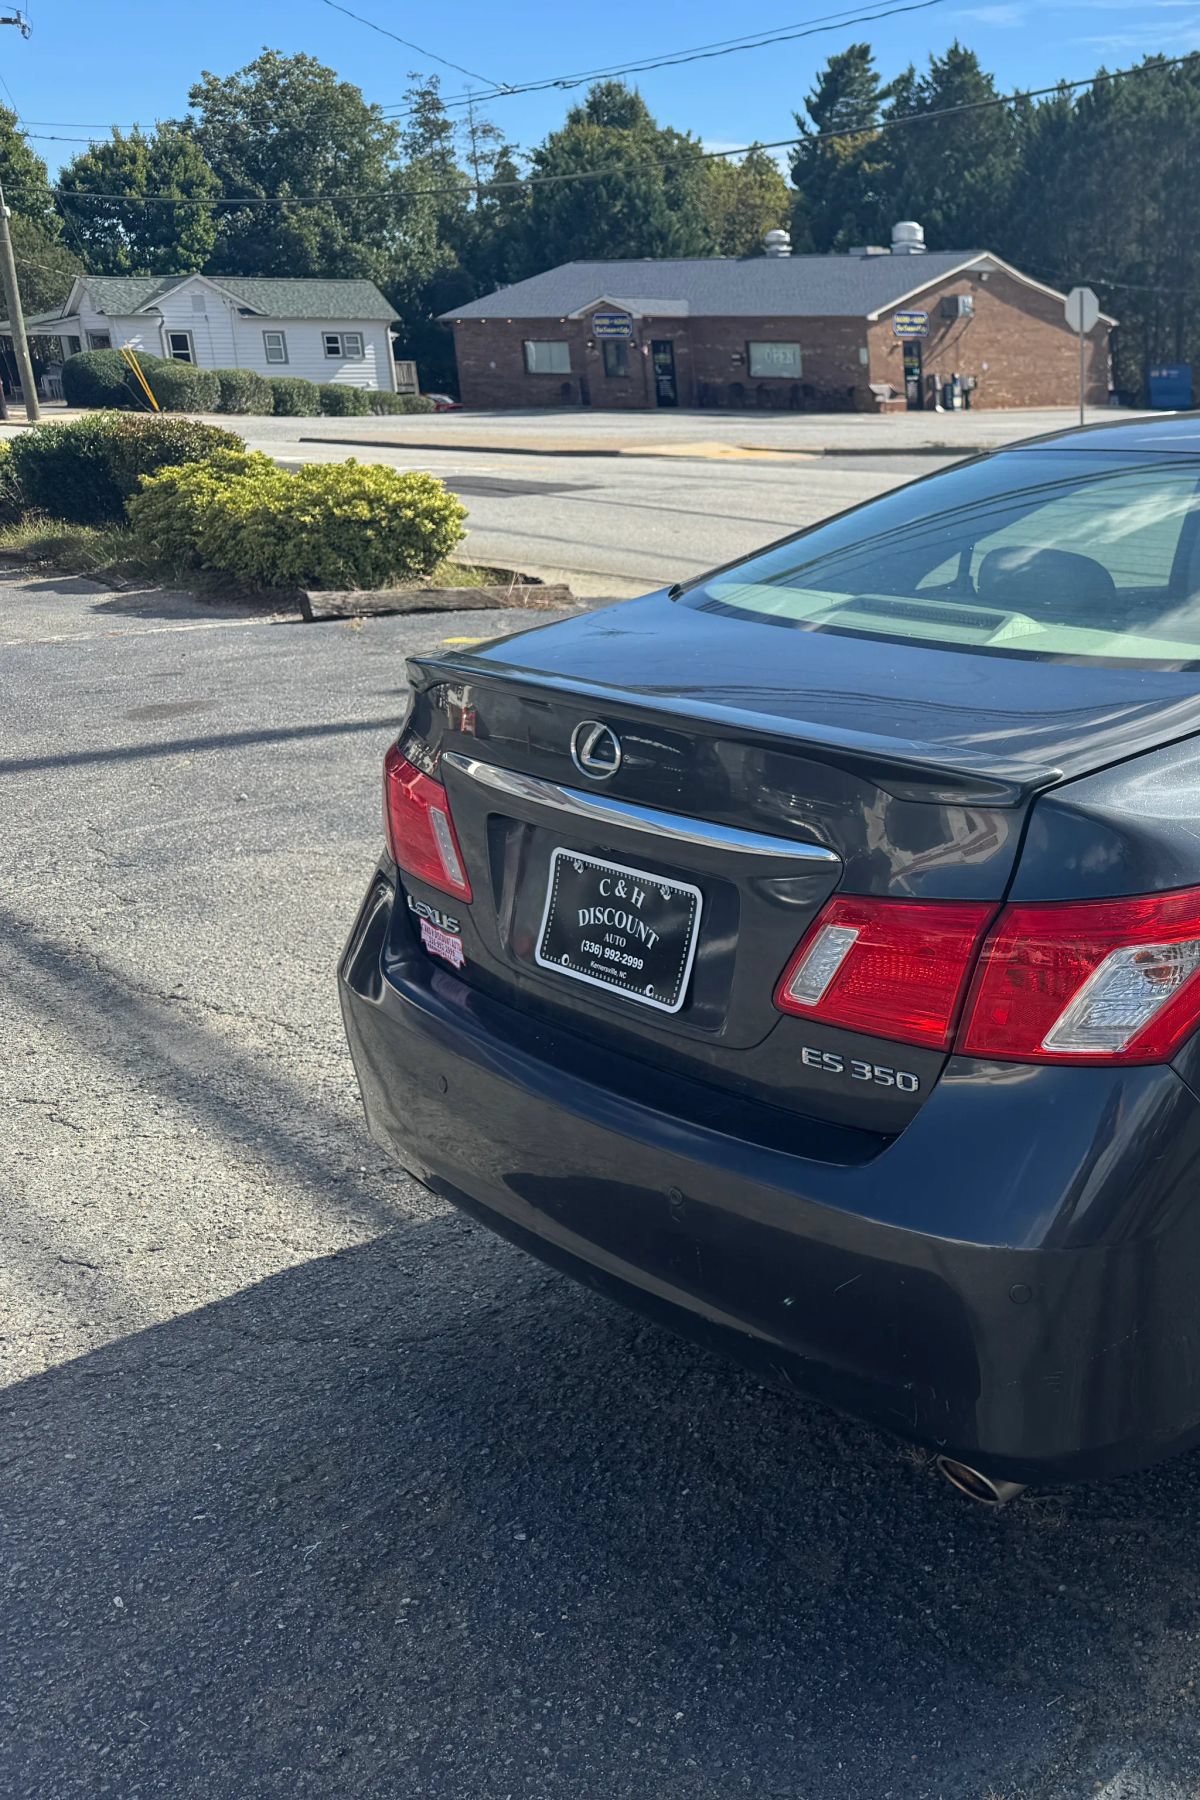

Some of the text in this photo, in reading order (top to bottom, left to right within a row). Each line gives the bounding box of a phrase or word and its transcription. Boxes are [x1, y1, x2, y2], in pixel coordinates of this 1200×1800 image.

[599, 878, 646, 909] C & H
[407, 895, 460, 934] LEXUS
[577, 906, 660, 950] DISCOUNT
[581, 939, 644, 970] (336) 992-2999
[603, 932, 627, 947] AUTO
[801, 1046, 919, 1093] ES 350
